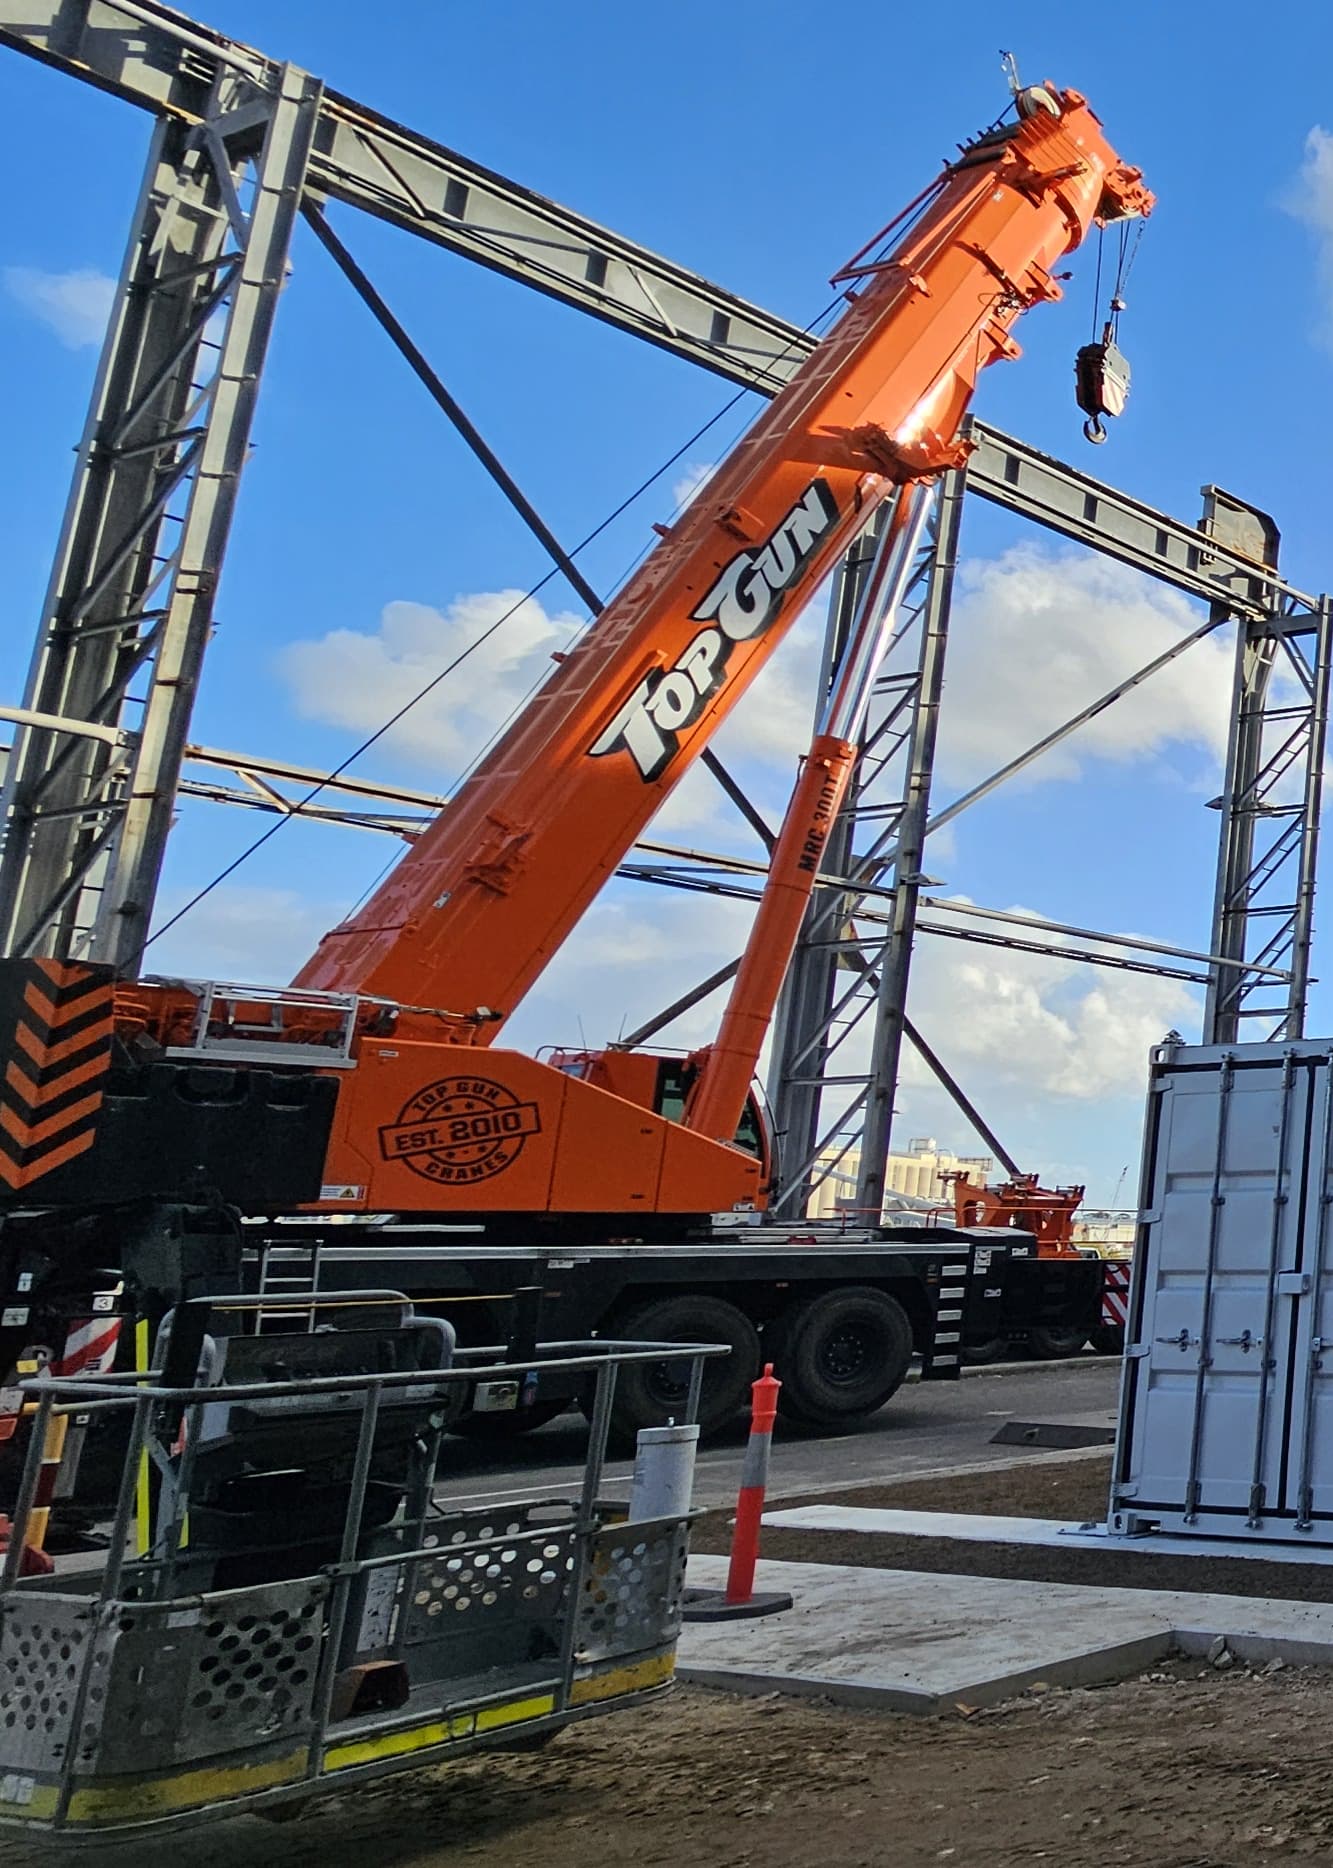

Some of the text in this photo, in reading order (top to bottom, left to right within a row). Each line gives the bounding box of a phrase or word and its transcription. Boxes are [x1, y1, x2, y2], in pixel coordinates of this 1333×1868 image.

[588, 484, 836, 781] TOP GUN
[799, 775, 838, 871] MRC 300T
[411, 1081, 501, 1112] TOP GUN
[394, 1110, 522, 1152] EST. 2010
[423, 1150, 509, 1180] CRANES
[98, 1298, 109, 1309] 3
